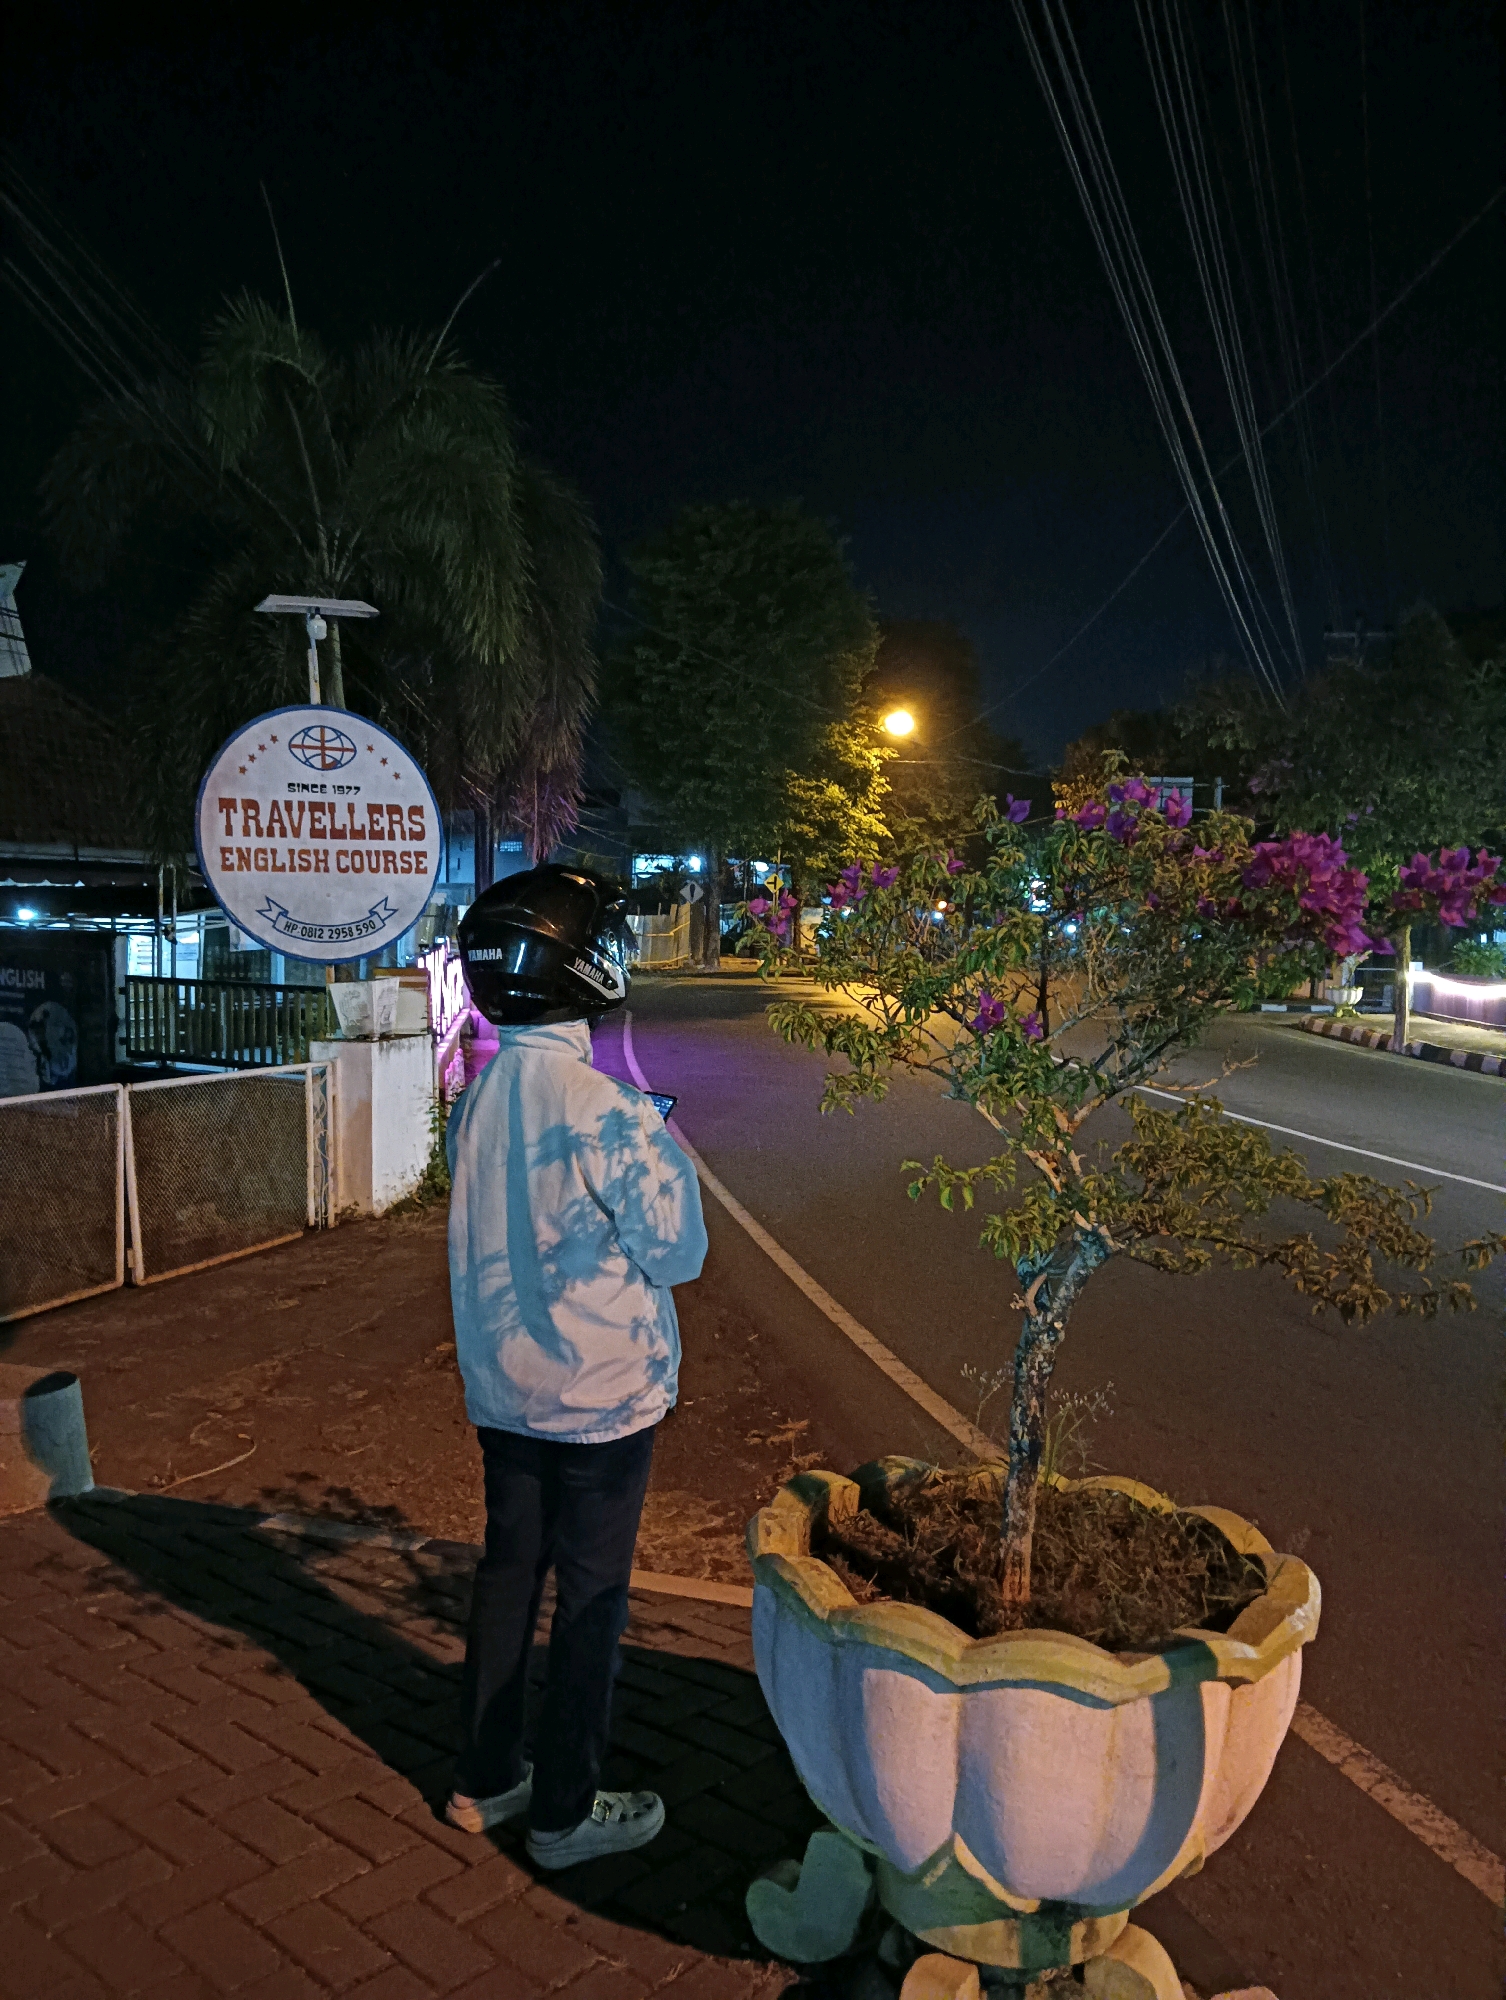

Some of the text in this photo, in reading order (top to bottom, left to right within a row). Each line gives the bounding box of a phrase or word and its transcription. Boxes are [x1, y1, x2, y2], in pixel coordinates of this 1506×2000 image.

[287, 782, 361, 796] SINCE 1977
[218, 797, 426, 842] TRAVELLERS
[219, 846, 428, 875] ENGLISH COURSE
[328, 927, 354, 940] 2958
[356, 919, 376, 936] 590
[467, 947, 503, 962] YAMAHA
[573, 956, 606, 985] YAMAHA
